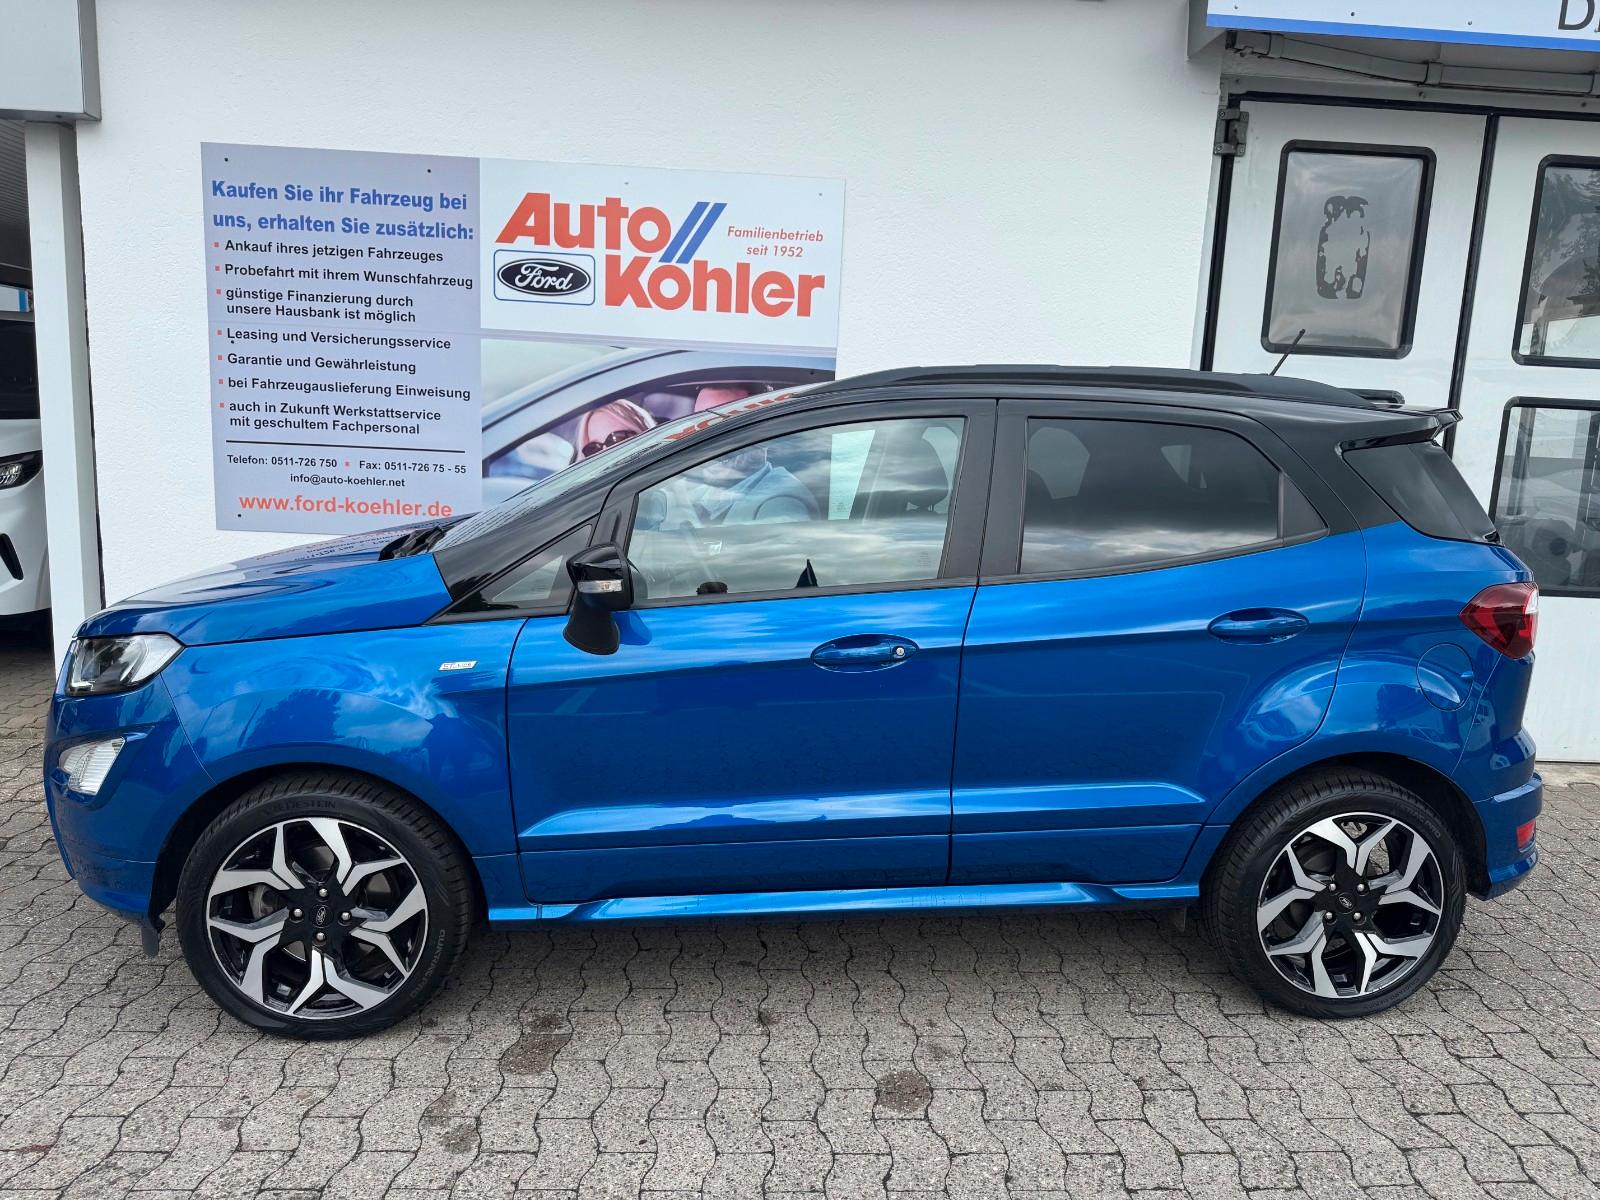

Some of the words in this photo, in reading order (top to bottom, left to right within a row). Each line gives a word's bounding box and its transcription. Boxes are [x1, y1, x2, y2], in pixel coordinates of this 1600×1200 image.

[212, 180, 277, 199] Kaufen
[285, 184, 313, 201] Sie
[320, 187, 344, 203] ihr
[350, 188, 433, 212] Fahrzeug
[440, 193, 466, 209] bei
[213, 215, 251, 231] uns,
[258, 214, 334, 232] erhalten
[342, 217, 369, 234] Sie
[376, 221, 473, 239] zusätzlich:
[495, 192, 672, 253] Auto
[728, 226, 823, 241] Familienbetrieb
[225, 240, 272, 252] Ankauf
[277, 243, 308, 254] ihres
[312, 246, 363, 259] jetzigen
[369, 247, 443, 263] Fahrzeuges
[747, 245, 768, 255] seit
[774, 245, 803, 257] 1952
[225, 264, 294, 277] Probefahrt
[299, 269, 318, 279] mit
[324, 269, 359, 280] ihrem
[364, 271, 472, 289] Wunschfahrzeug
[514, 263, 574, 291] Ford
[226, 288, 283, 302] günstige
[288, 290, 371, 307] Finanzierung
[376, 295, 413, 306] durch
[227, 306, 271, 315] unsere
[276, 305, 340, 318] Hausbank
[345, 310, 360, 319] ist
[365, 311, 415, 323] möglich
[228, 328, 277, 344] Leasing
[283, 332, 306, 341] und
[311, 332, 450, 348] Versicherungsservice
[228, 353, 282, 365] Garantie
[287, 357, 310, 367] und
[315, 357, 415, 374] Gewährleistung
[229, 377, 247, 387] bei
[252, 378, 391, 397] Fahrzeugauslieferung
[397, 385, 470, 401] Einweisung
[230, 402, 260, 411] auch
[280, 403, 329, 415] Zukunft
[333, 405, 440, 420] Werkstattservice
[230, 417, 250, 426] mit
[254, 418, 328, 429] geschultem
[333, 420, 419, 434] Fachpersonal
[227, 455, 268, 464] Telefon:
[272, 457, 316, 466] 0511-726
[320, 459, 337, 467] 750
[360, 461, 381, 469] Fax:
[385, 462, 429, 471] 0511-726
[433, 464, 444, 472] 75
[455, 465, 466, 473] 55
[291, 474, 405, 486] info@auto-koehler.net
[239, 495, 452, 517] www.ford-koehler.de
